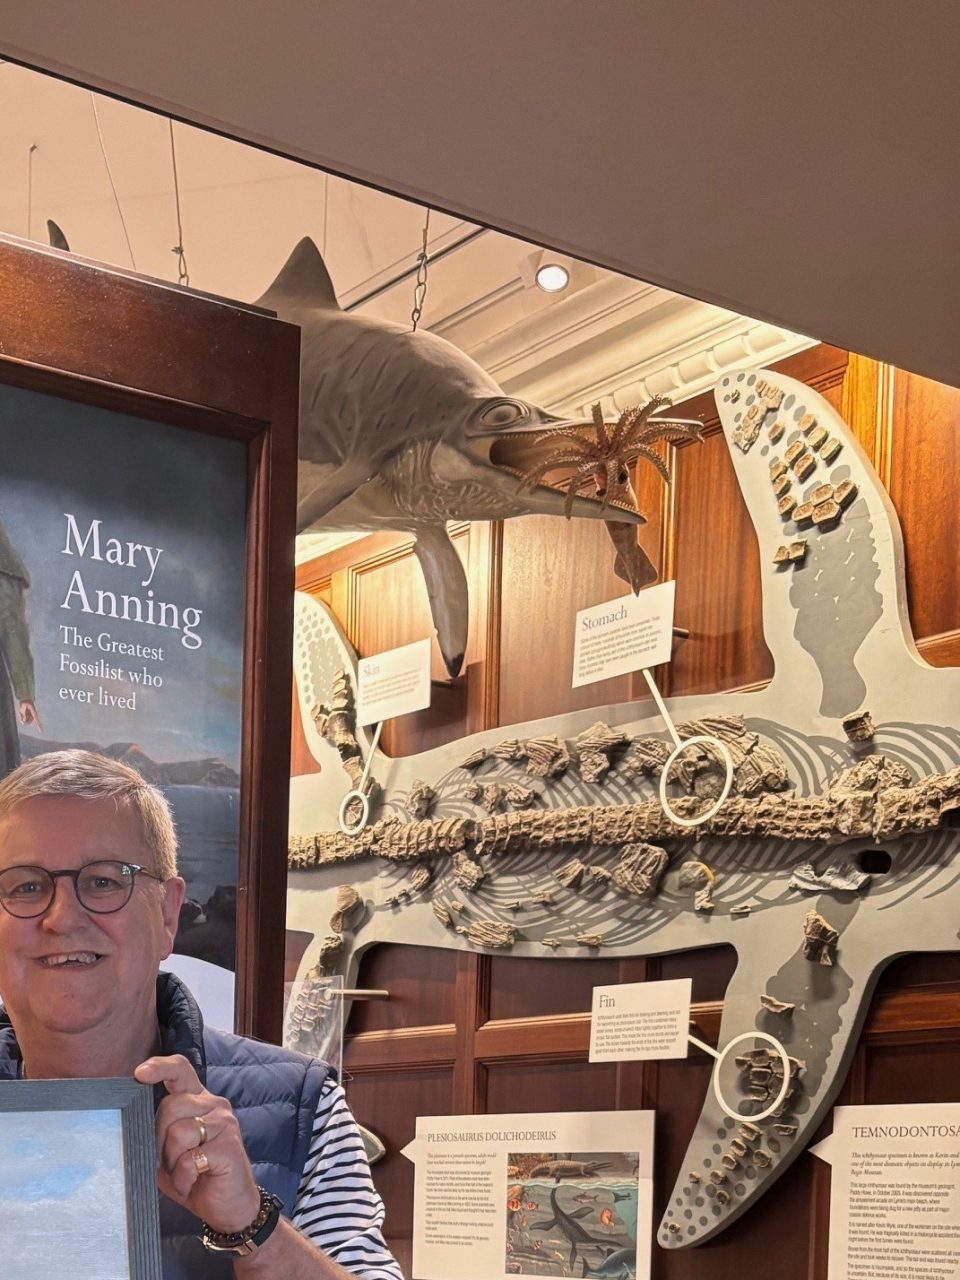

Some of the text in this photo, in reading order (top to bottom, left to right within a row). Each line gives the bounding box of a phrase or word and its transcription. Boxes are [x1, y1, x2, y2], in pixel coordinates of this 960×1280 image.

[61, 513, 164, 586] Mary
[60, 570, 203, 650] Anning
[581, 604, 628, 632] Stomach
[59, 624, 164, 661] The Greatest
[59, 653, 163, 688] Fossilist who
[59, 686, 137, 711] ever lived
[599, 994, 616, 1008] Fin
[427, 1131, 557, 1142] PLESIOSAURUS DOLICHODEIRUS
